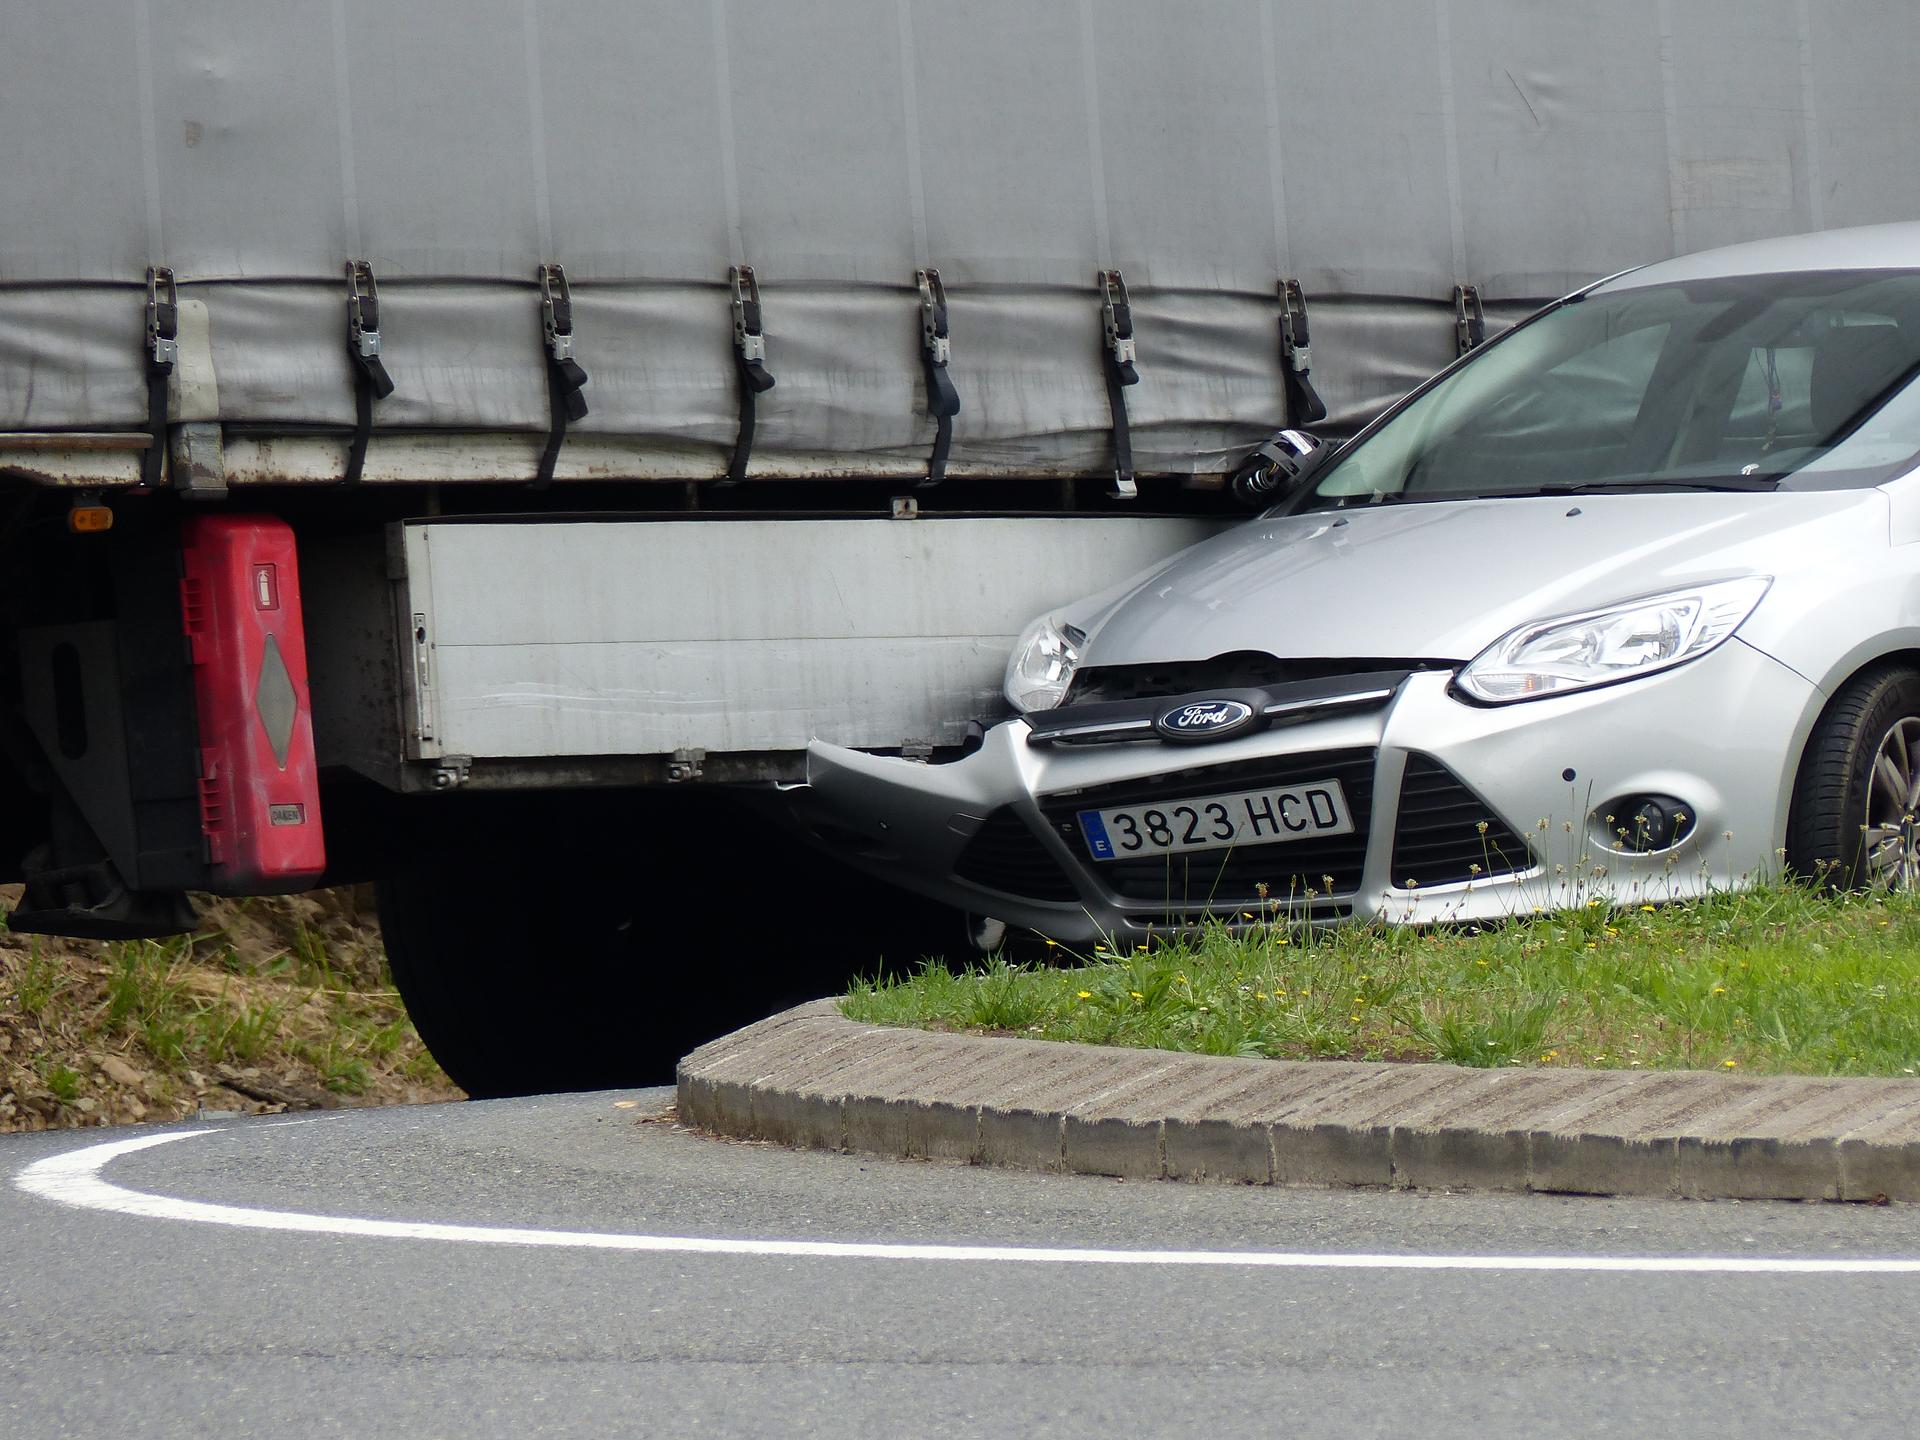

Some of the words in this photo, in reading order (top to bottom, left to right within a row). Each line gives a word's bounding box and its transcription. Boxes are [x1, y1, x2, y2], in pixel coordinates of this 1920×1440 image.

[1178, 704, 1229, 727] Ford
[1113, 802, 1235, 851] 3823
[1244, 789, 1339, 836] HCD
[1095, 840, 1108, 851] E
